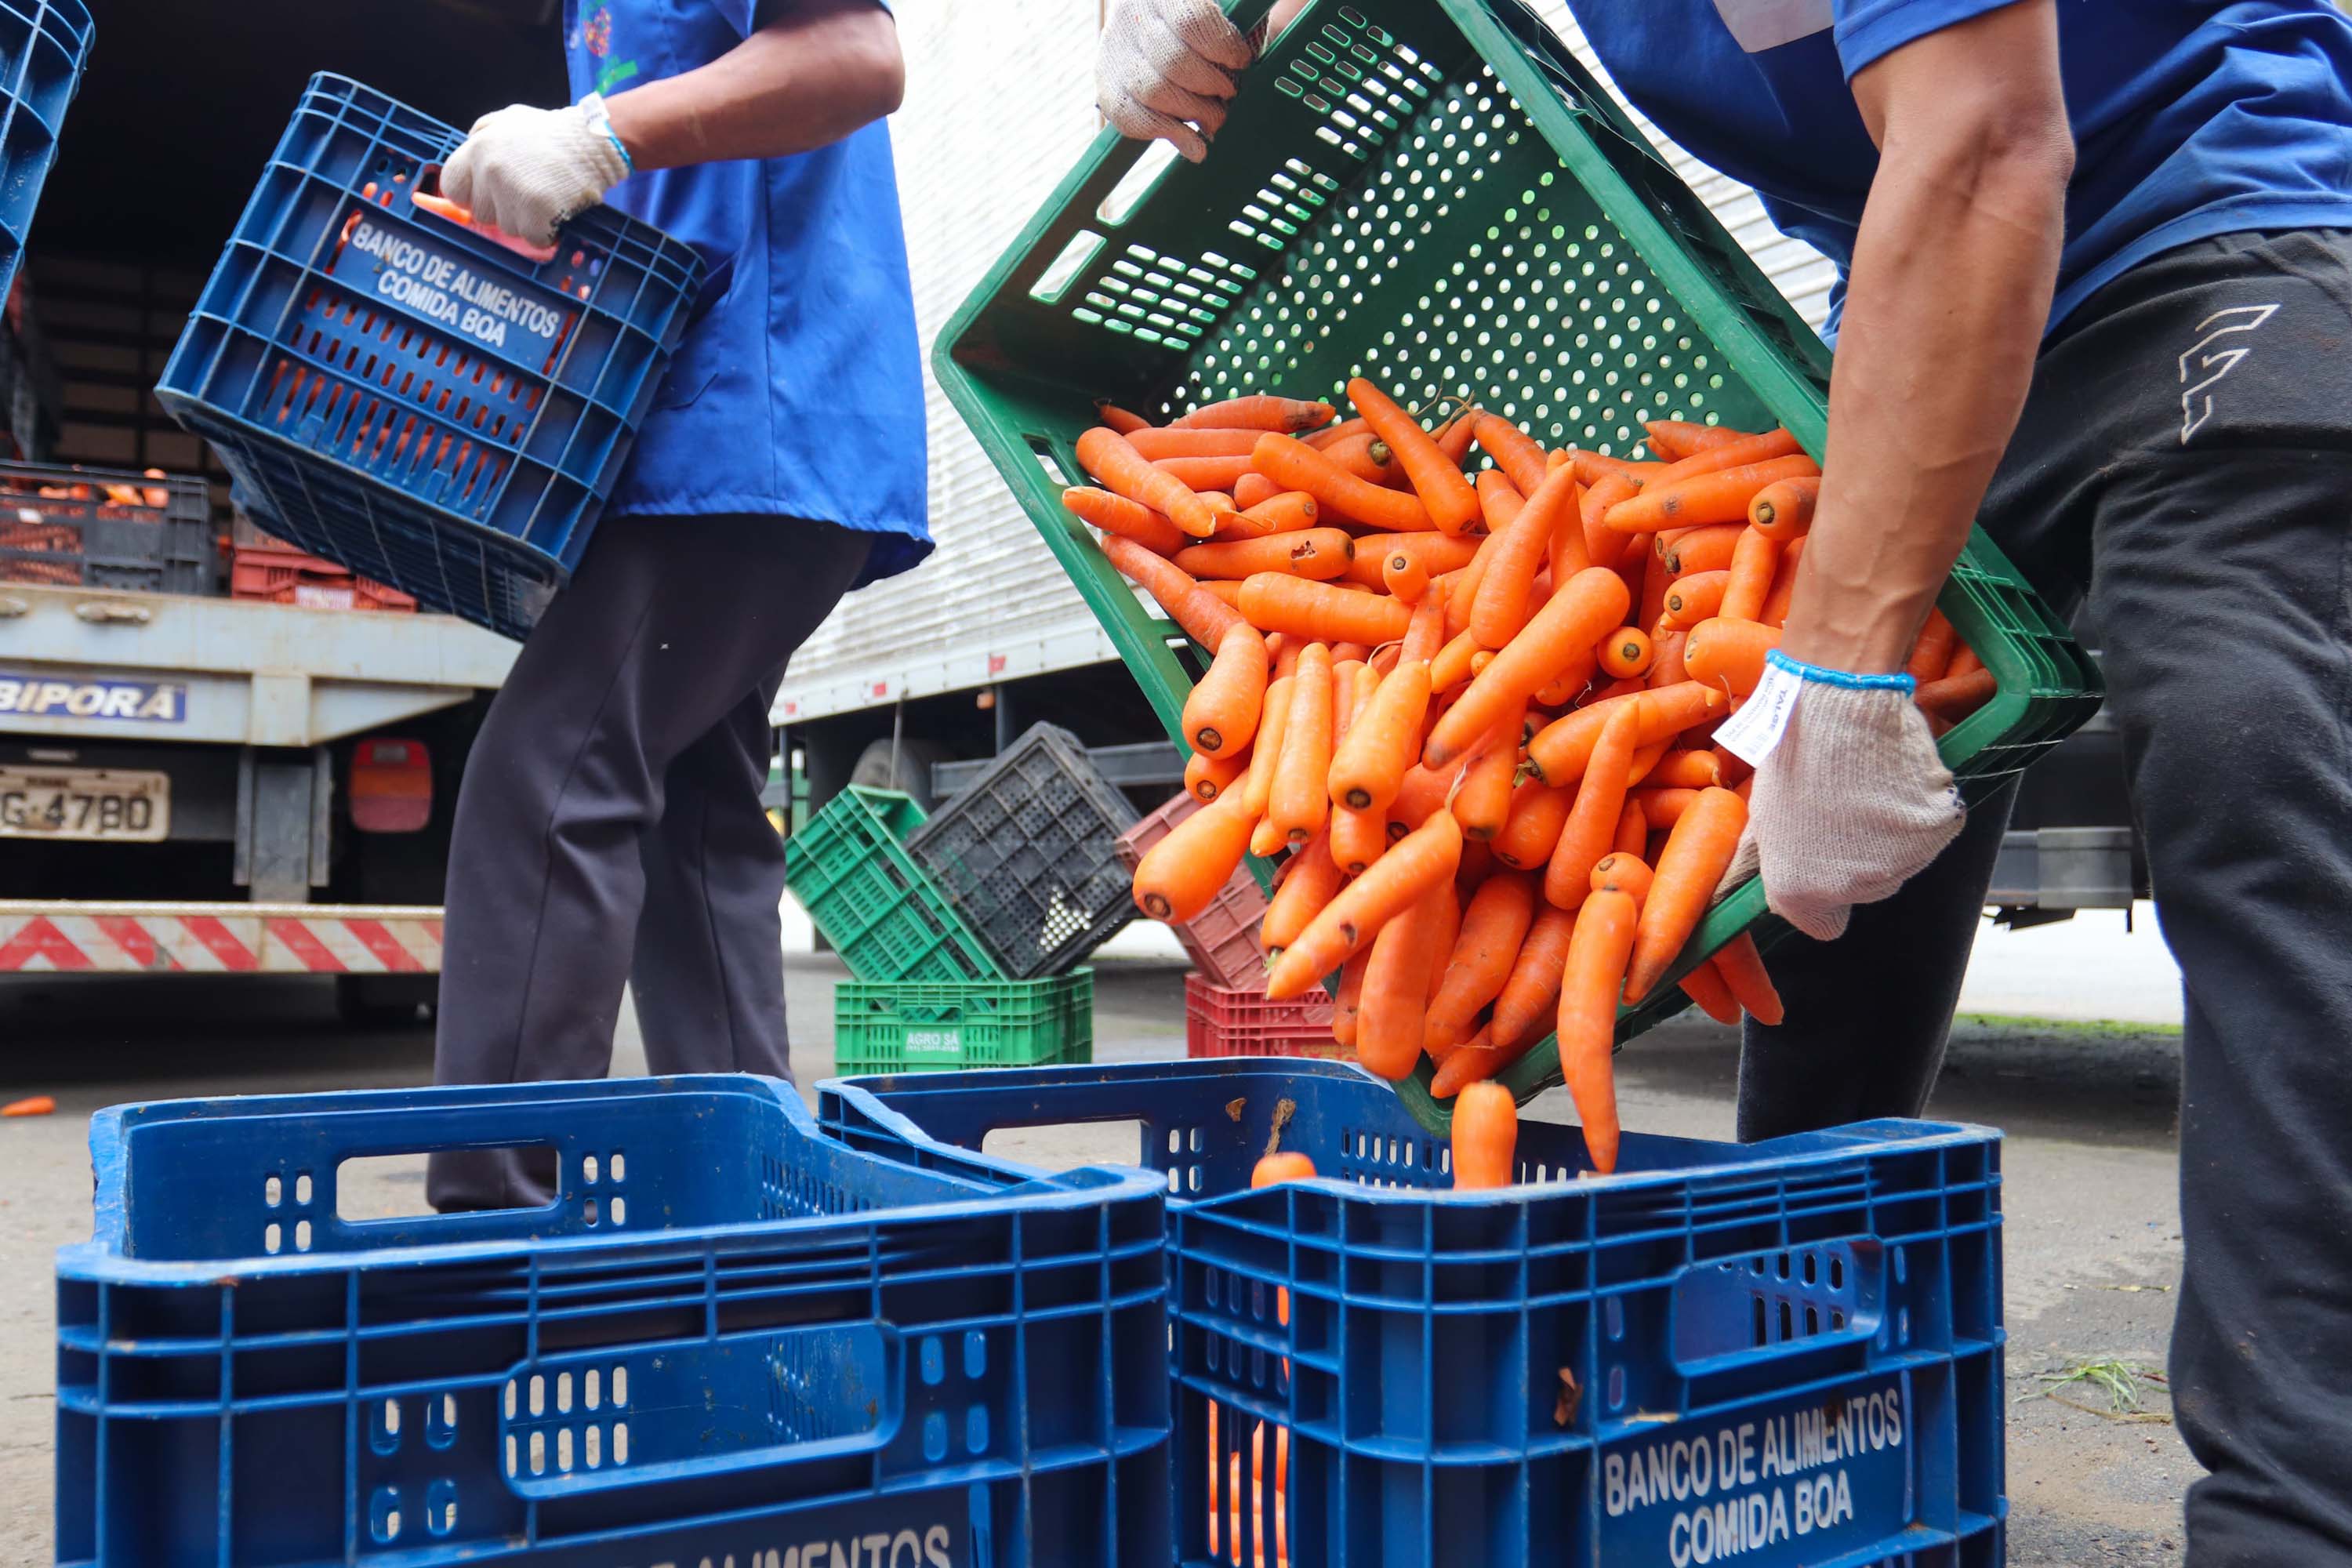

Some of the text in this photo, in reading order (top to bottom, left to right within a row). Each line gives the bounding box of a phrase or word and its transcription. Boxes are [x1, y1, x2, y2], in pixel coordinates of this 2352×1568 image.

[352, 223, 561, 339] BANCO DE ALIMENTOS
[378, 270, 506, 347] COMIDA BOA
[906, 1033, 941, 1045] AGRO
[1605, 1388, 1903, 1517] BANCO DE ALIMENTOS
[1669, 1469, 1853, 1568] COMIDA BOA
